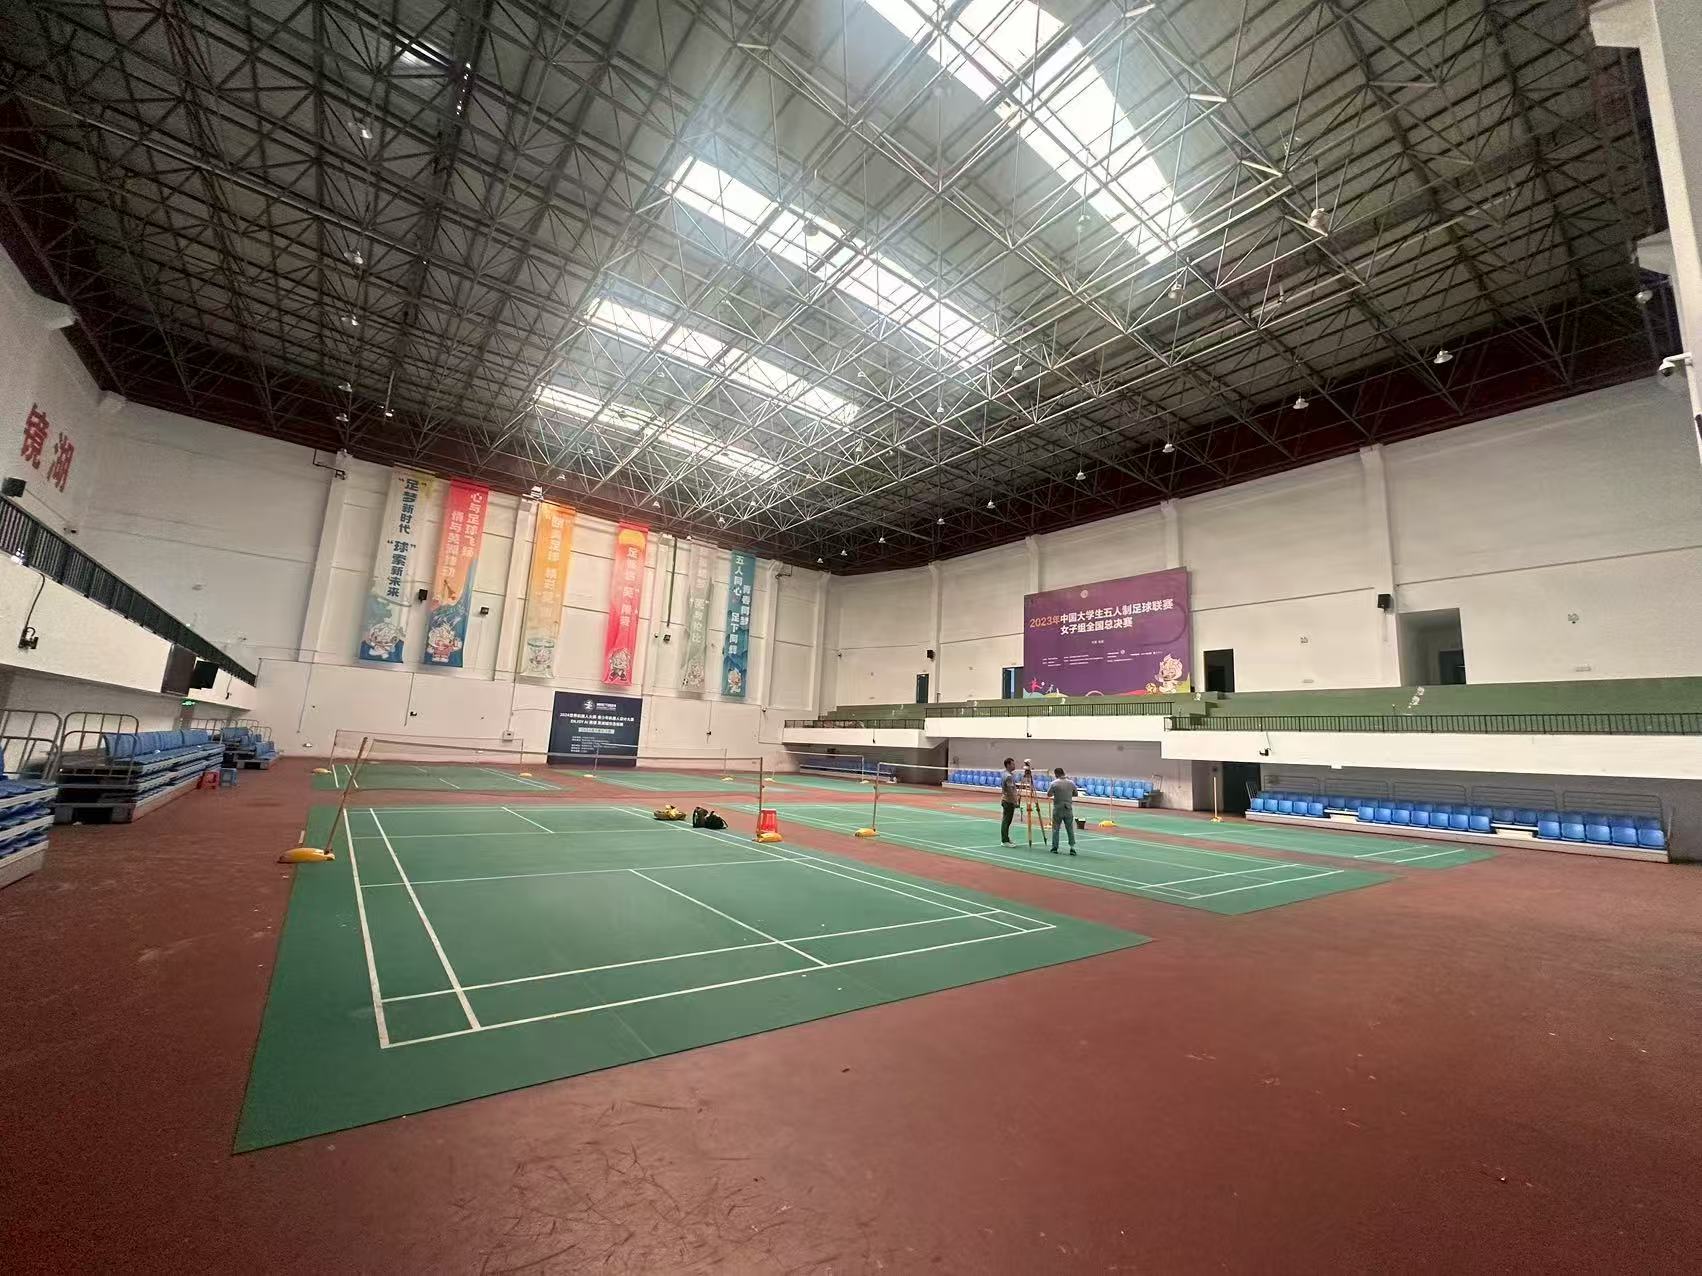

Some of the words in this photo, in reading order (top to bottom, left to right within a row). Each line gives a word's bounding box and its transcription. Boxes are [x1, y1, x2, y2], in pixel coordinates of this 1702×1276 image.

[732, 555, 745, 596] 五人同心
[1029, 598, 1174, 628] 2023年中国大学生五人制足球联赛
[1060, 617, 1133, 635] 女子组全国总决赛
